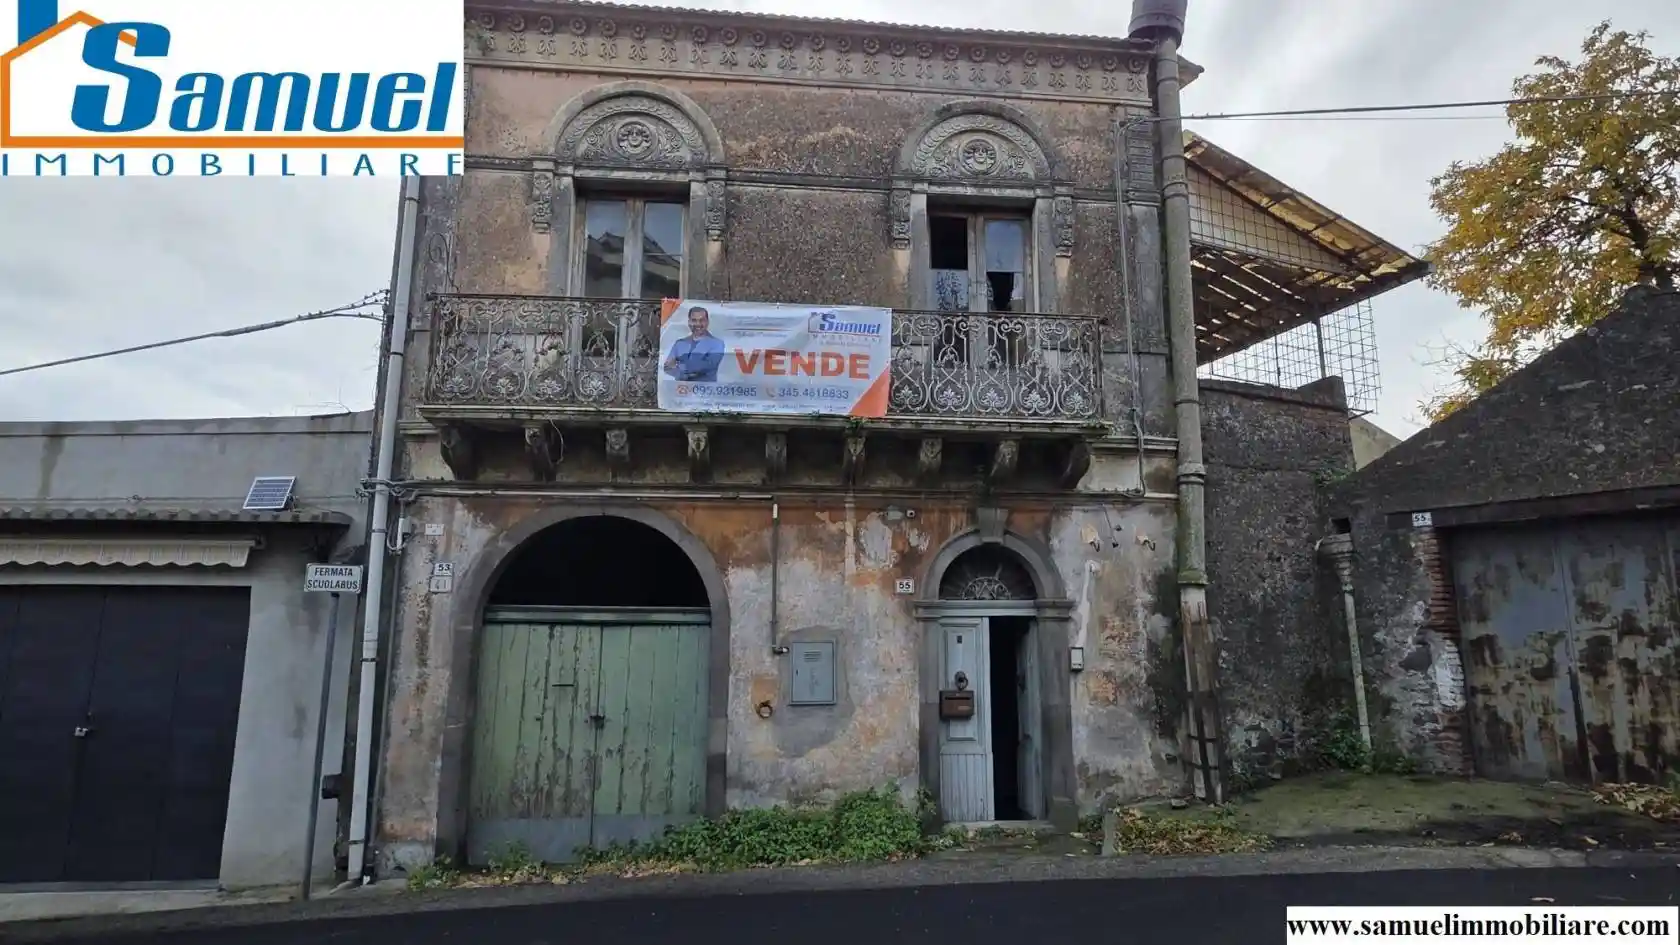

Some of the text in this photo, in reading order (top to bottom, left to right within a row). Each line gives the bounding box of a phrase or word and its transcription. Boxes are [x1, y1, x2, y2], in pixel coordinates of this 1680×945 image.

[819, 313, 881, 334] Samuel
[734, 348, 871, 380] VENDE
[314, 567, 353, 577] FERMATA
[438, 563, 451, 572] 53
[307, 579, 358, 590] SCUOLABUS
[899, 581, 911, 589] 55
